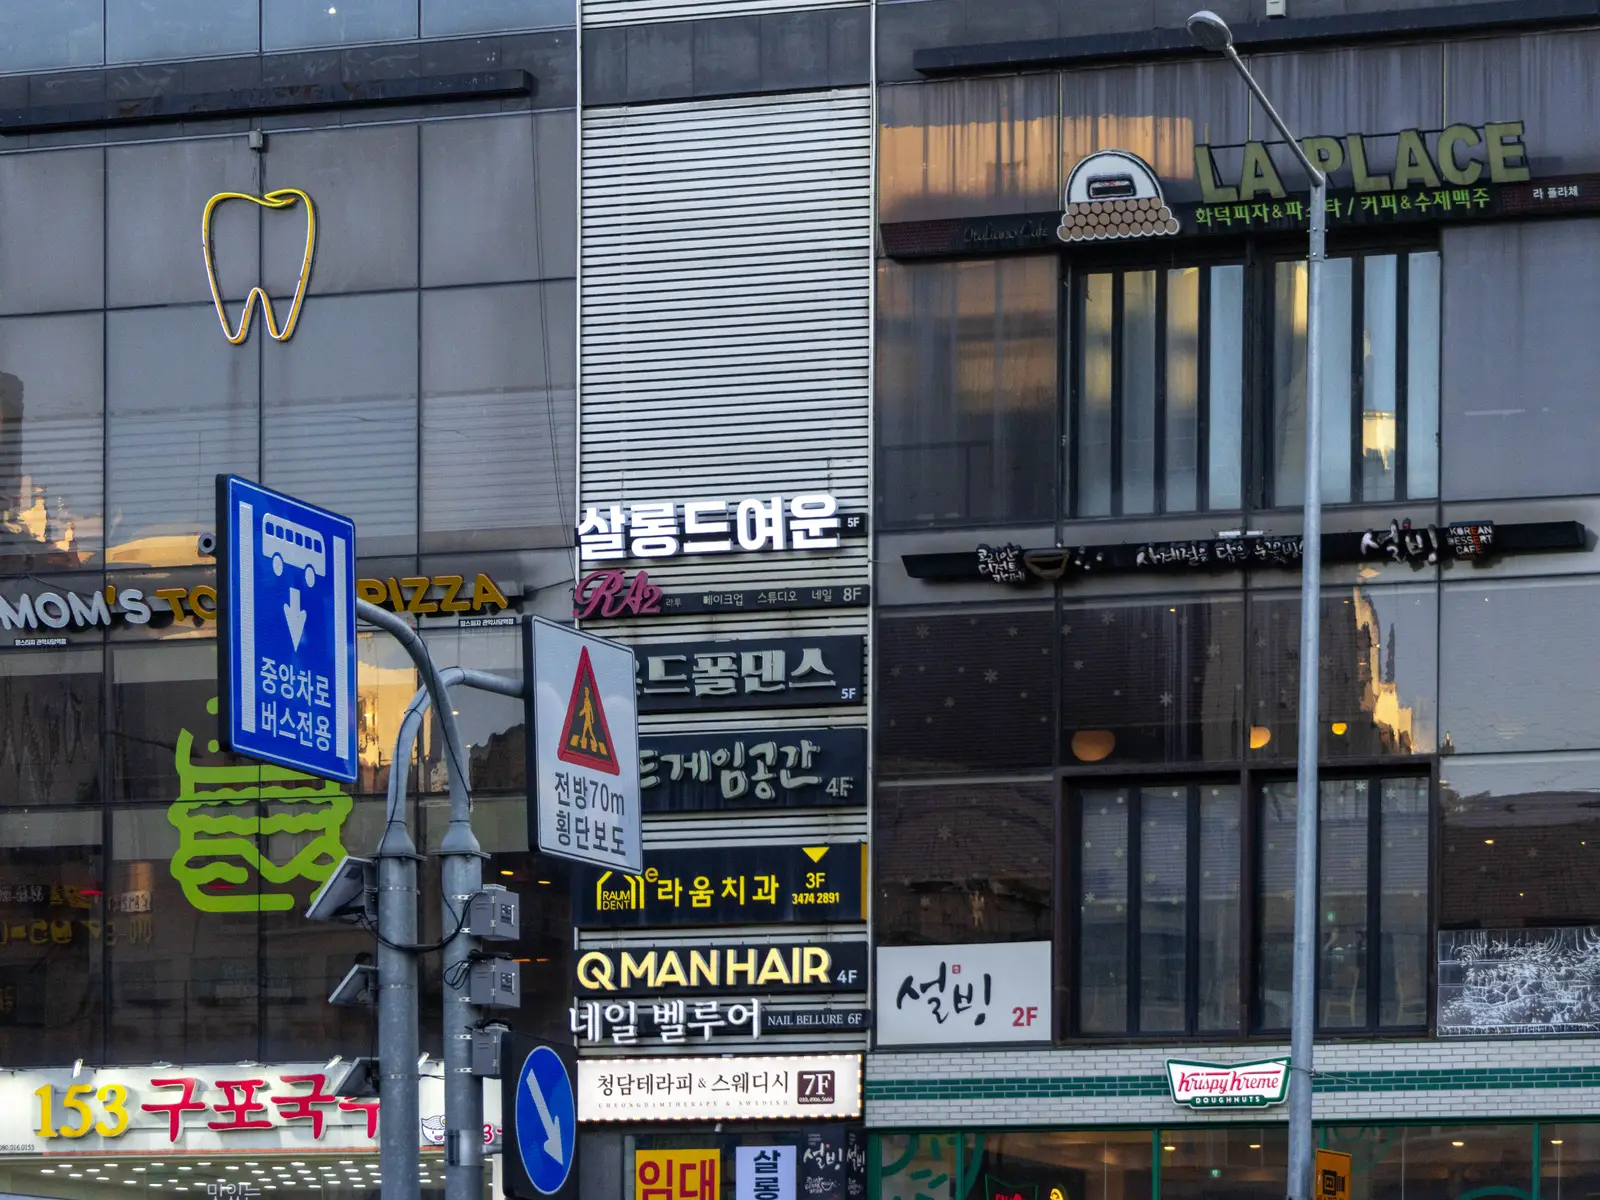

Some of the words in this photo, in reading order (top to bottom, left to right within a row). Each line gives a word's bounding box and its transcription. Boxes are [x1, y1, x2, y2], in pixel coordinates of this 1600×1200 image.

[1195, 140, 1288, 203] LA
[1302, 121, 1531, 192] PLACE
[1532, 187, 1544, 200] 라
[1195, 197, 1342, 227] 화덕피자&파타
[1361, 186, 1490, 213] 커피&수제맥주
[577, 493, 842, 561] 살롱드여운
[847, 517, 860, 528] 5F
[1449, 525, 1492, 536] KOREAN
[1254, 540, 1304, 565] 눈꽃빙
[1448, 534, 1493, 546] DESSERT
[1456, 545, 1481, 555] CAFE
[0, 585, 151, 630] MOM'S
[155, 585, 216, 622] TO
[356, 573, 508, 613] PIZZA
[757, 590, 798, 604] 스튜디오
[811, 588, 832, 602] 네일
[843, 587, 862, 602] 8F
[260, 656, 332, 708] 중앙차로
[635, 648, 836, 697] 드폴댄스
[841, 687, 856, 700] 5F
[261, 700, 332, 752] 버스전용
[825, 776, 853, 797] 4F
[556, 810, 626, 856] 횡단보도
[805, 872, 826, 889] 3F
[602, 890, 631, 901] RAUM
[602, 900, 630, 911] DENT
[791, 893, 815, 905] 3474
[816, 892, 840, 904] 2891
[836, 969, 858, 983] 4F
[896, 961, 992, 1026] 설빙
[1011, 1006, 1039, 1027] 2F
[568, 1000, 639, 1045] 네일
[652, 998, 762, 1044] 벨루어
[767, 1015, 795, 1026] NAIL
[796, 1014, 843, 1025] BELLURE
[847, 1012, 863, 1025] 6F
[597, 1072, 693, 1097] 청담테라피
[698, 1078, 707, 1088] &
[711, 1070, 789, 1094] 스웨디시
[801, 1074, 832, 1096] 7F
[1178, 1071, 1231, 1095] Krispy
[1229, 1069, 1282, 1091] Kreme
[34, 1083, 129, 1138] 153
[1195, 1096, 1260, 1104] DOUGHNUTS
[638, 1159, 716, 1200] 임대
